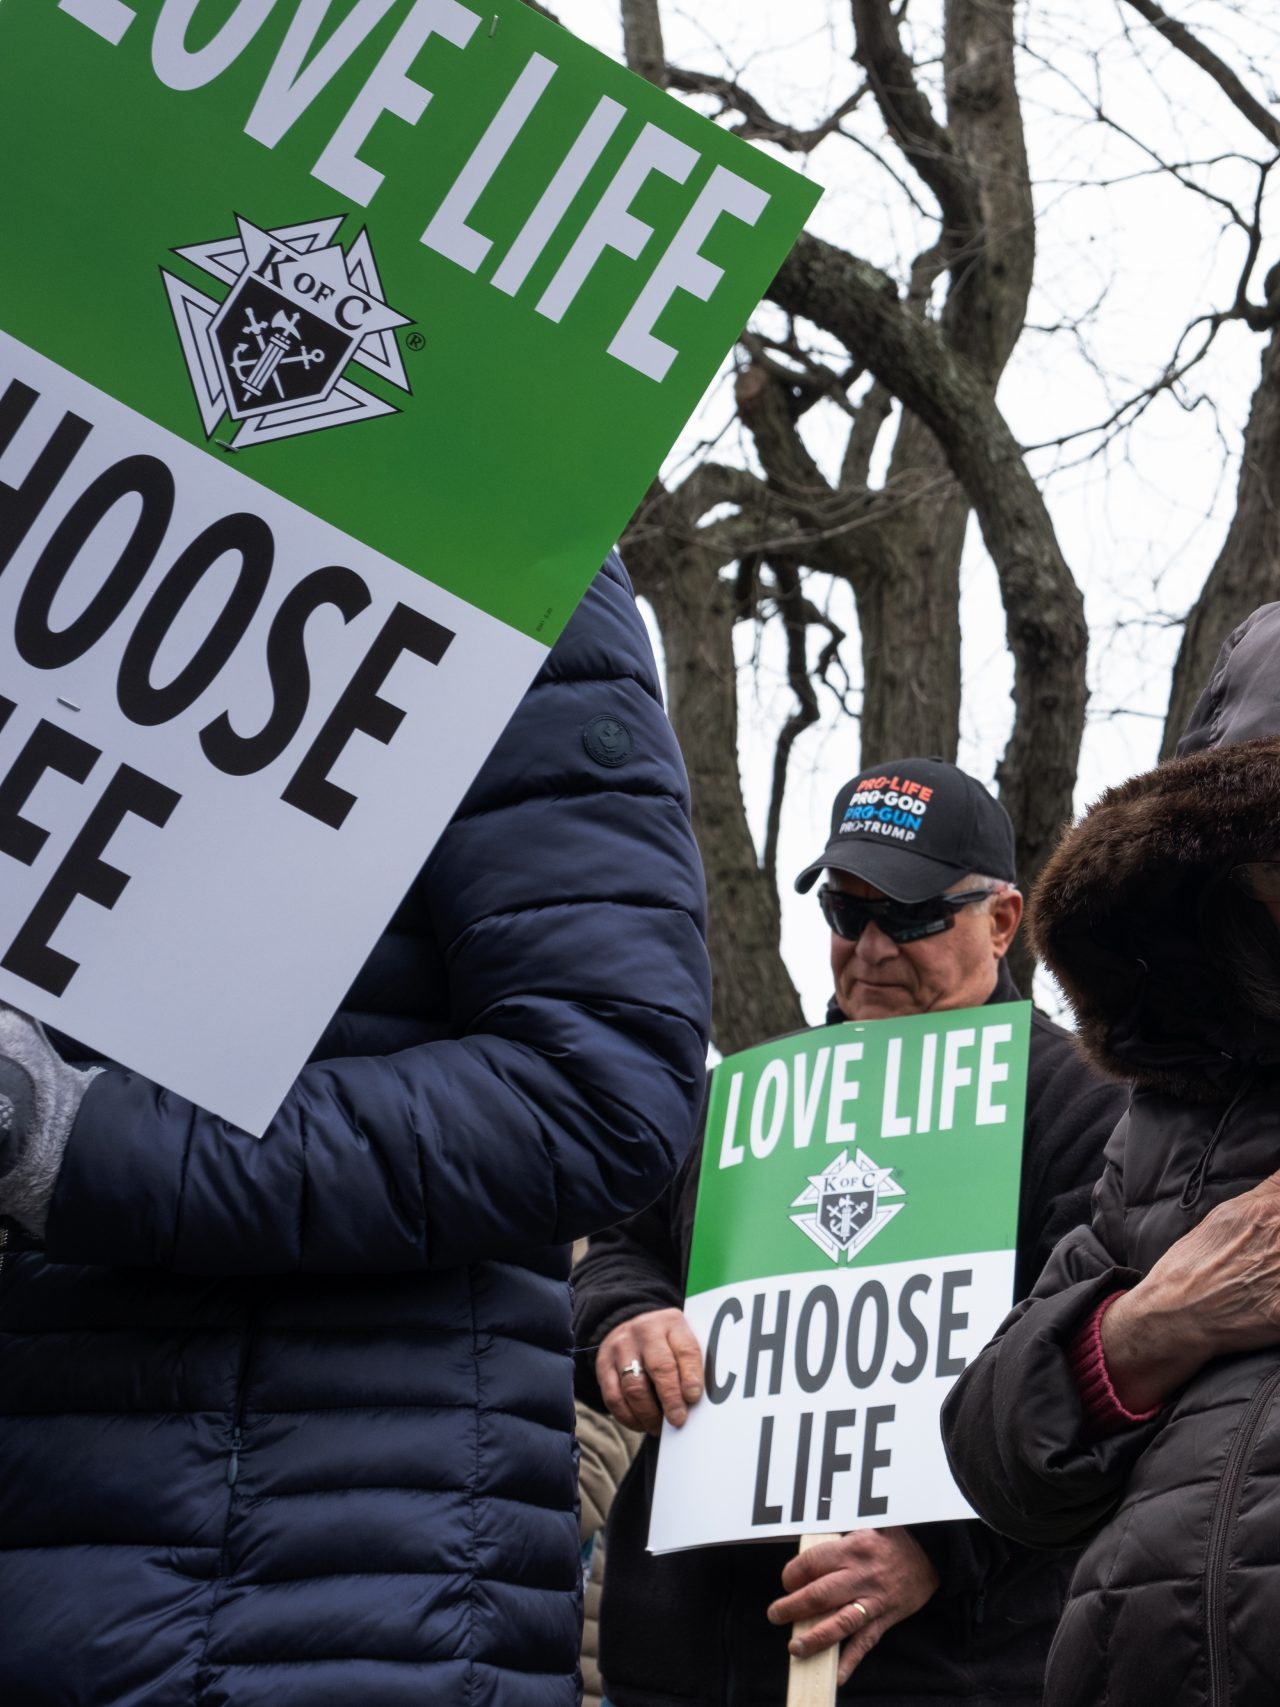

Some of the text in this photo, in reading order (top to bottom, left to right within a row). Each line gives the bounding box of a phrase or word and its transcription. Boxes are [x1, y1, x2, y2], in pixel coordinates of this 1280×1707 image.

[420, 51, 772, 384] LIFE
[252, 243, 373, 331] K OF C
[0, 377, 456, 831] HOOSE
[838, 820, 916, 842] PRO-TRUMP
[843, 805, 923, 832] PRO-GUN
[849, 789, 927, 816] PRO-GOD
[856, 775, 934, 803] PRO-LIFE
[718, 1023, 1013, 1170] LOVE LIFE
[823, 1173, 876, 1193] K OF C
[704, 1268, 974, 1406] CHOOSE
[751, 1404, 897, 1527] LIFE
